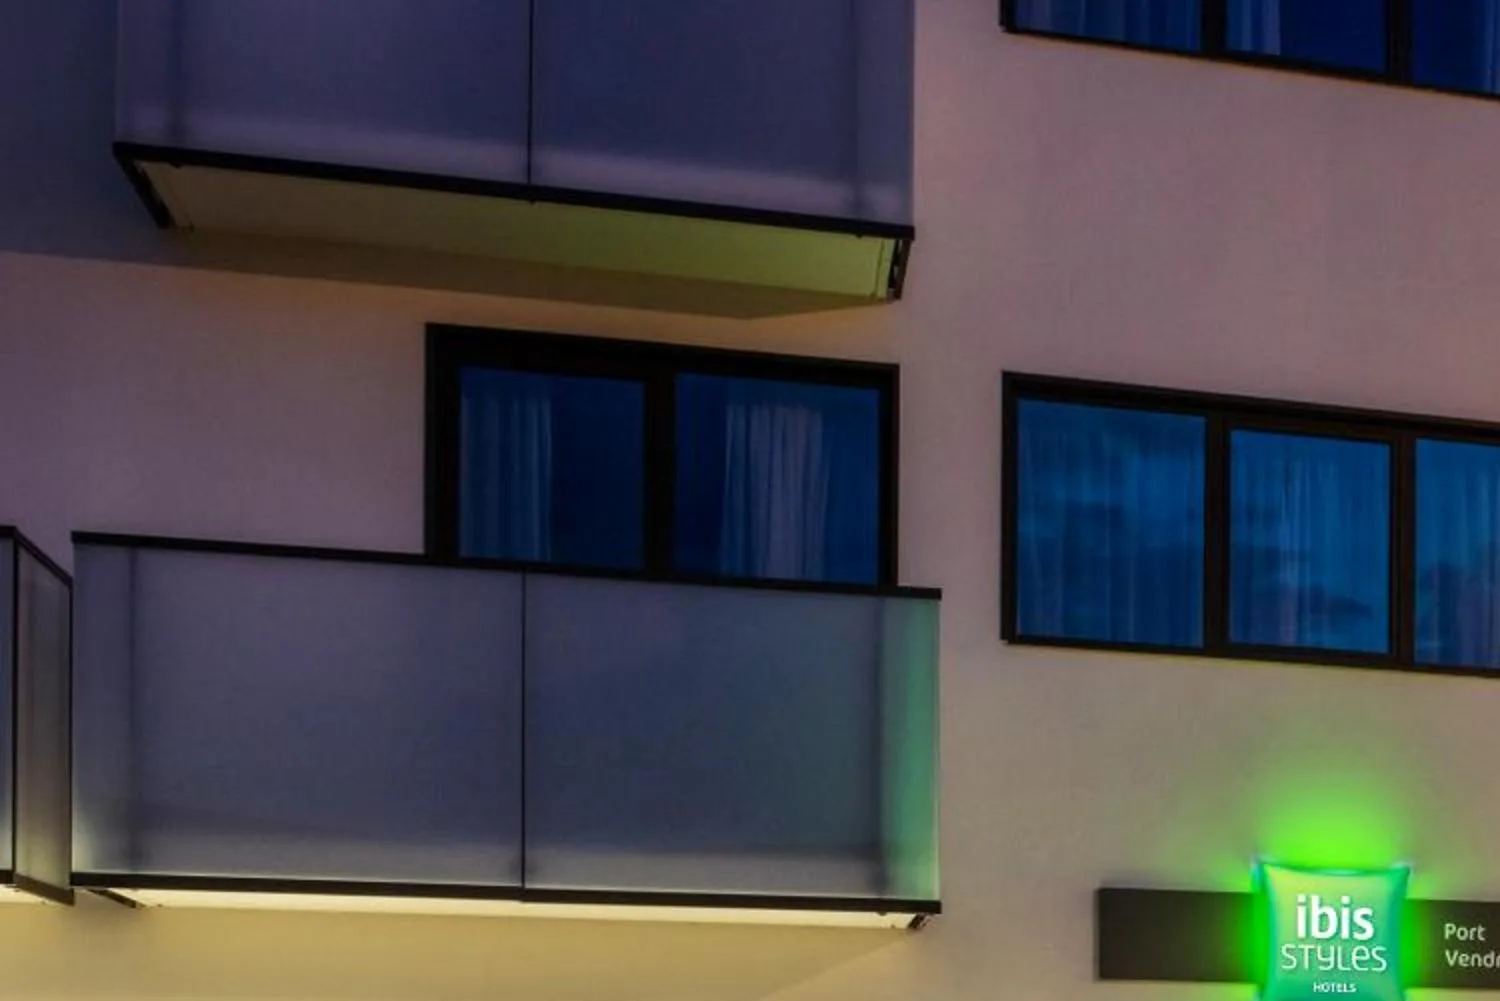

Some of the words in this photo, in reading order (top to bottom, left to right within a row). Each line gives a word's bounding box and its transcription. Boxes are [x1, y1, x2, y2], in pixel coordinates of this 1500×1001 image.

[1296, 894, 1375, 941] ibis
[1443, 922, 1486, 941] Port
[1312, 982, 1358, 993] HOTELS
